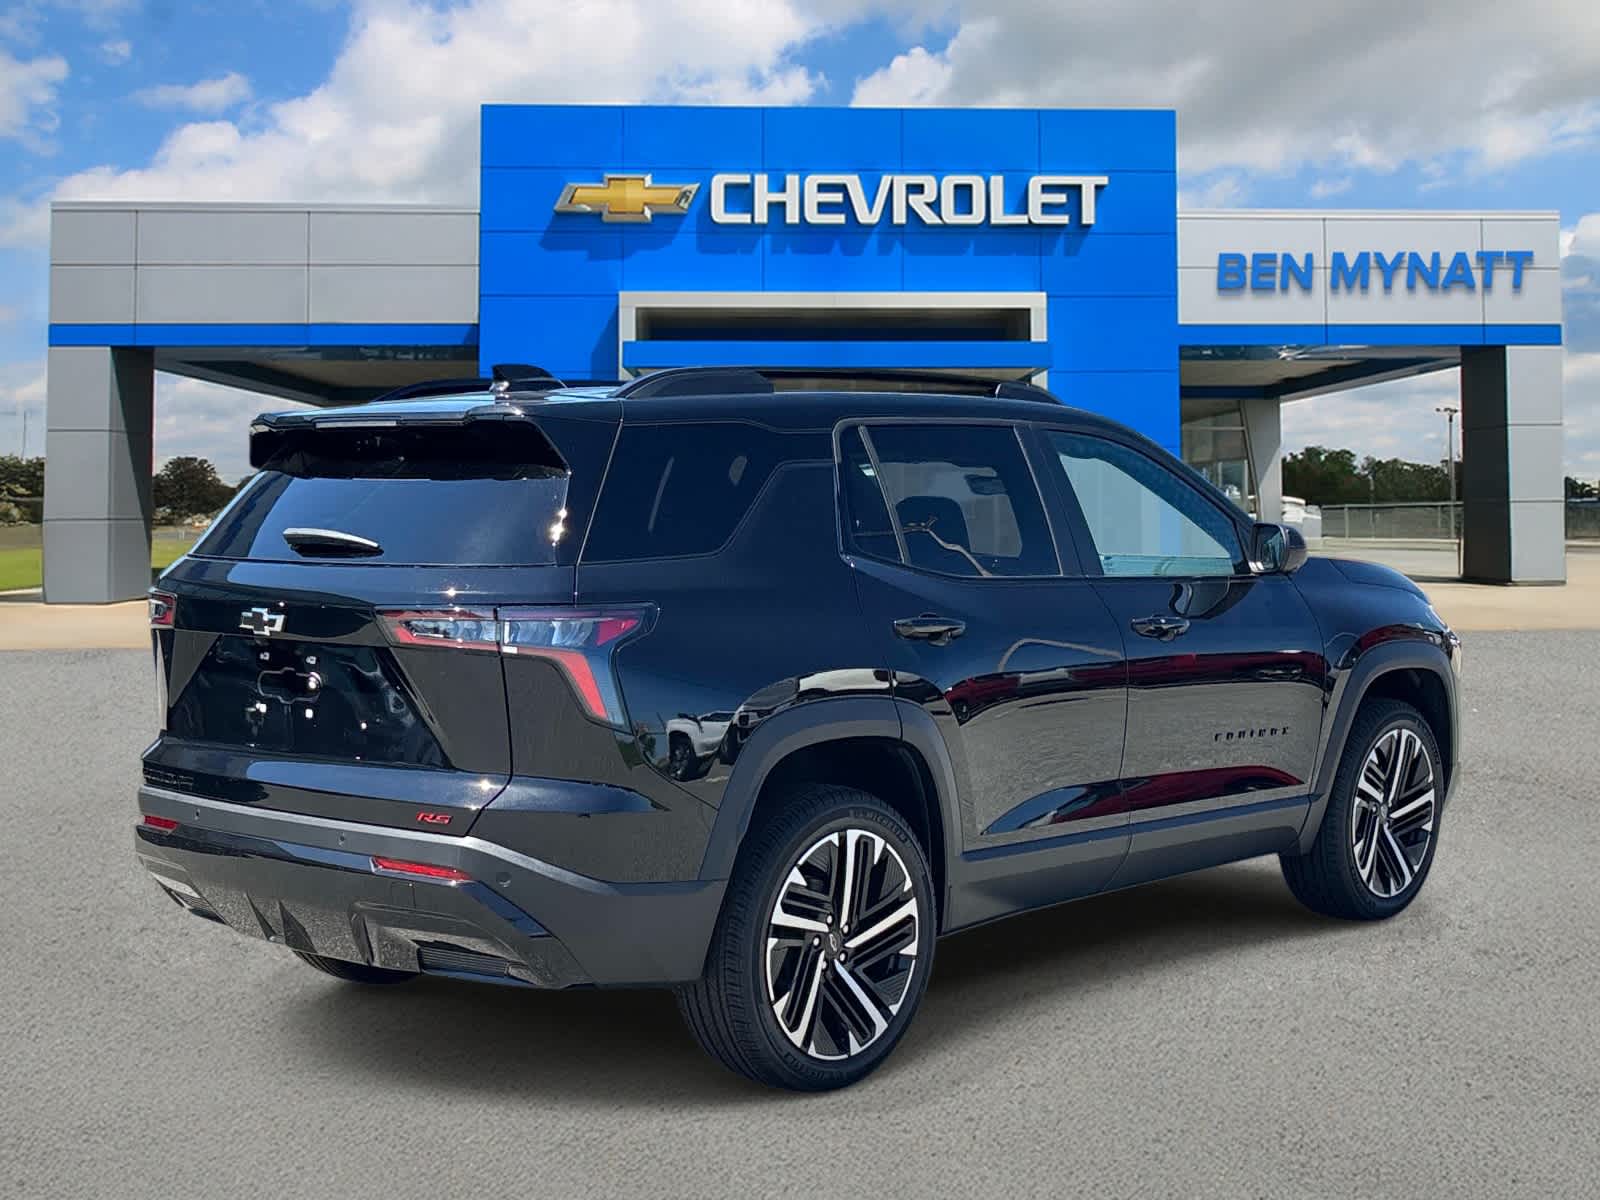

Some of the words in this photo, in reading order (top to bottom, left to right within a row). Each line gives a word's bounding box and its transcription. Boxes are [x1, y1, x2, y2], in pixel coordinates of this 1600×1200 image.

[711, 174, 1109, 226] CHEVROLET
[1217, 252, 1314, 291] BEN
[1330, 250, 1534, 291] MYNATT
[416, 811, 452, 826] RS
